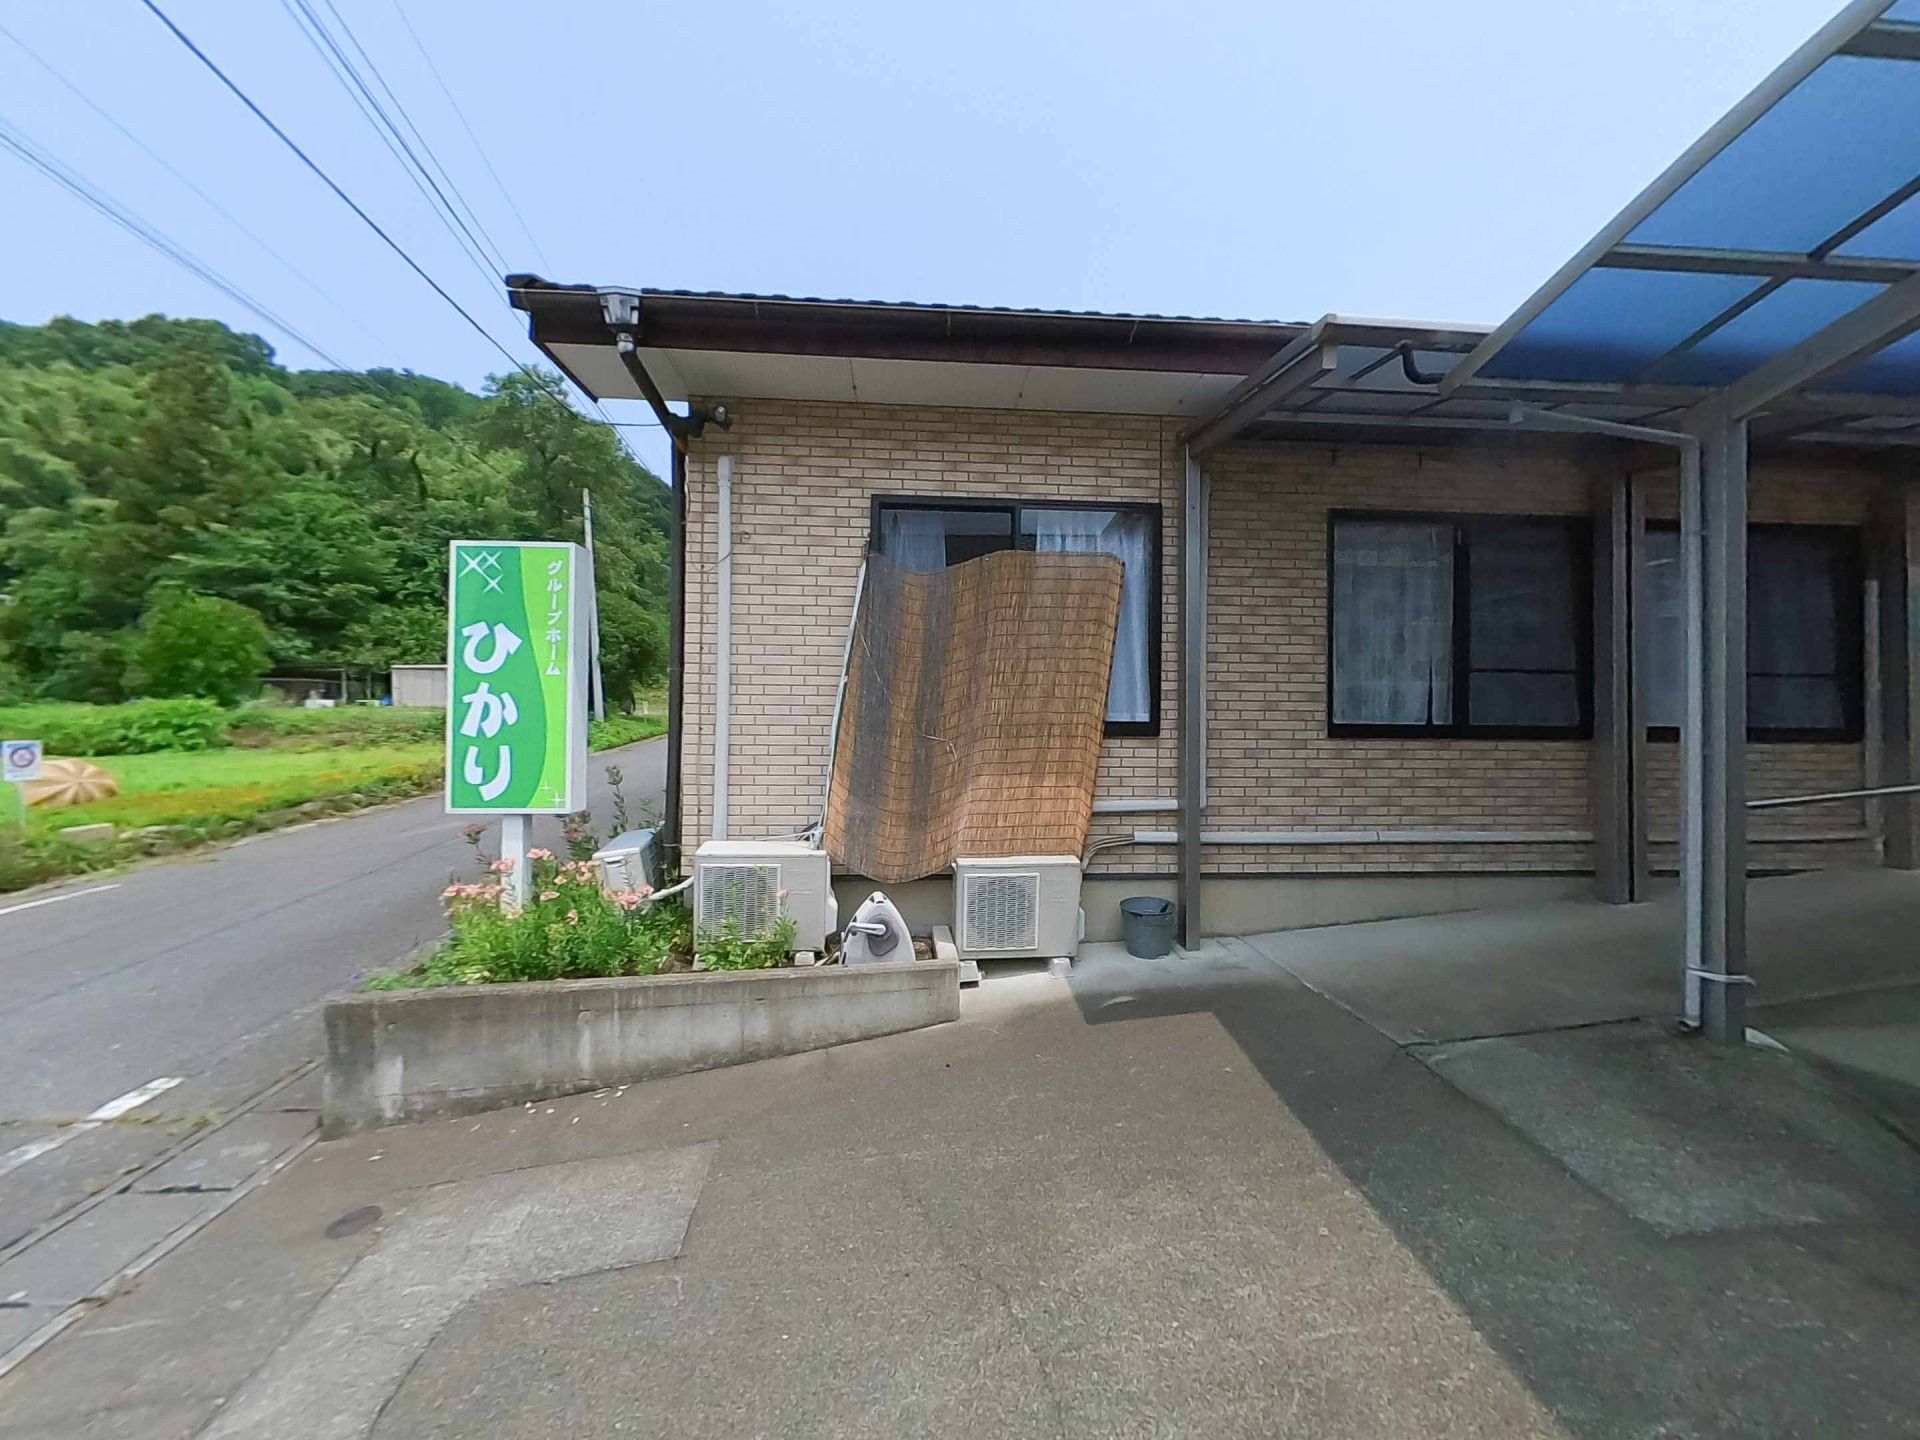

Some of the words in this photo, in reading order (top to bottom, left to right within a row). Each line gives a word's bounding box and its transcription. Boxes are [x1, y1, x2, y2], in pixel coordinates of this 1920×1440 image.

[545, 560, 563, 675] グループホーム
[460, 621, 522, 802] ひかり
